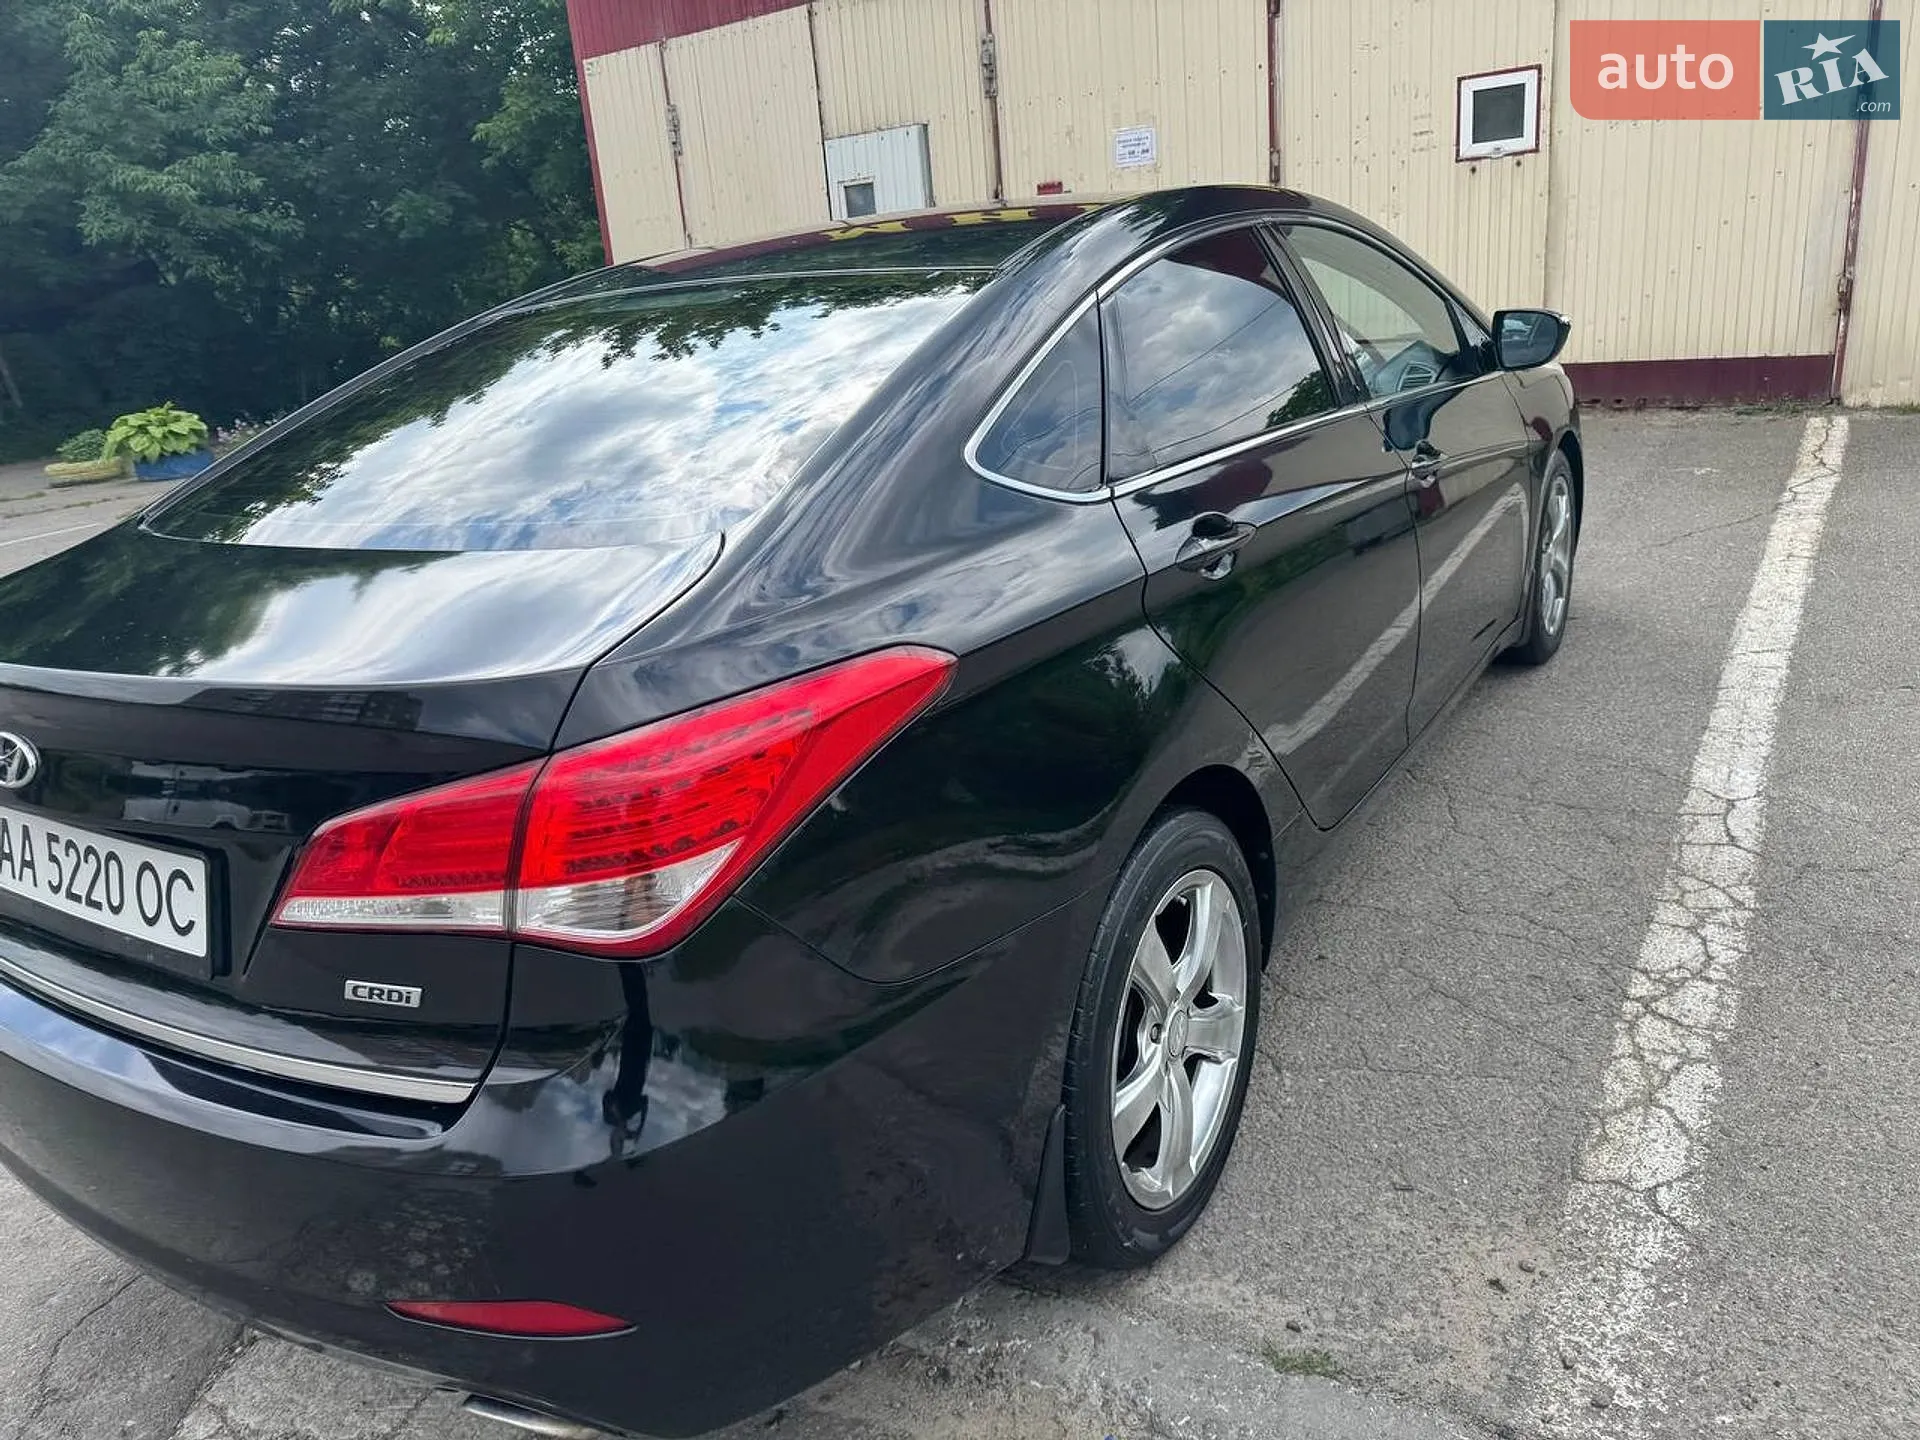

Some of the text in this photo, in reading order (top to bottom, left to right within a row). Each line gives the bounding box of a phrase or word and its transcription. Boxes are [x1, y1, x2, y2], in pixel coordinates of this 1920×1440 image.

[0, 817, 196, 937] AA 5220 OC
[351, 985, 412, 1005] CRDi
